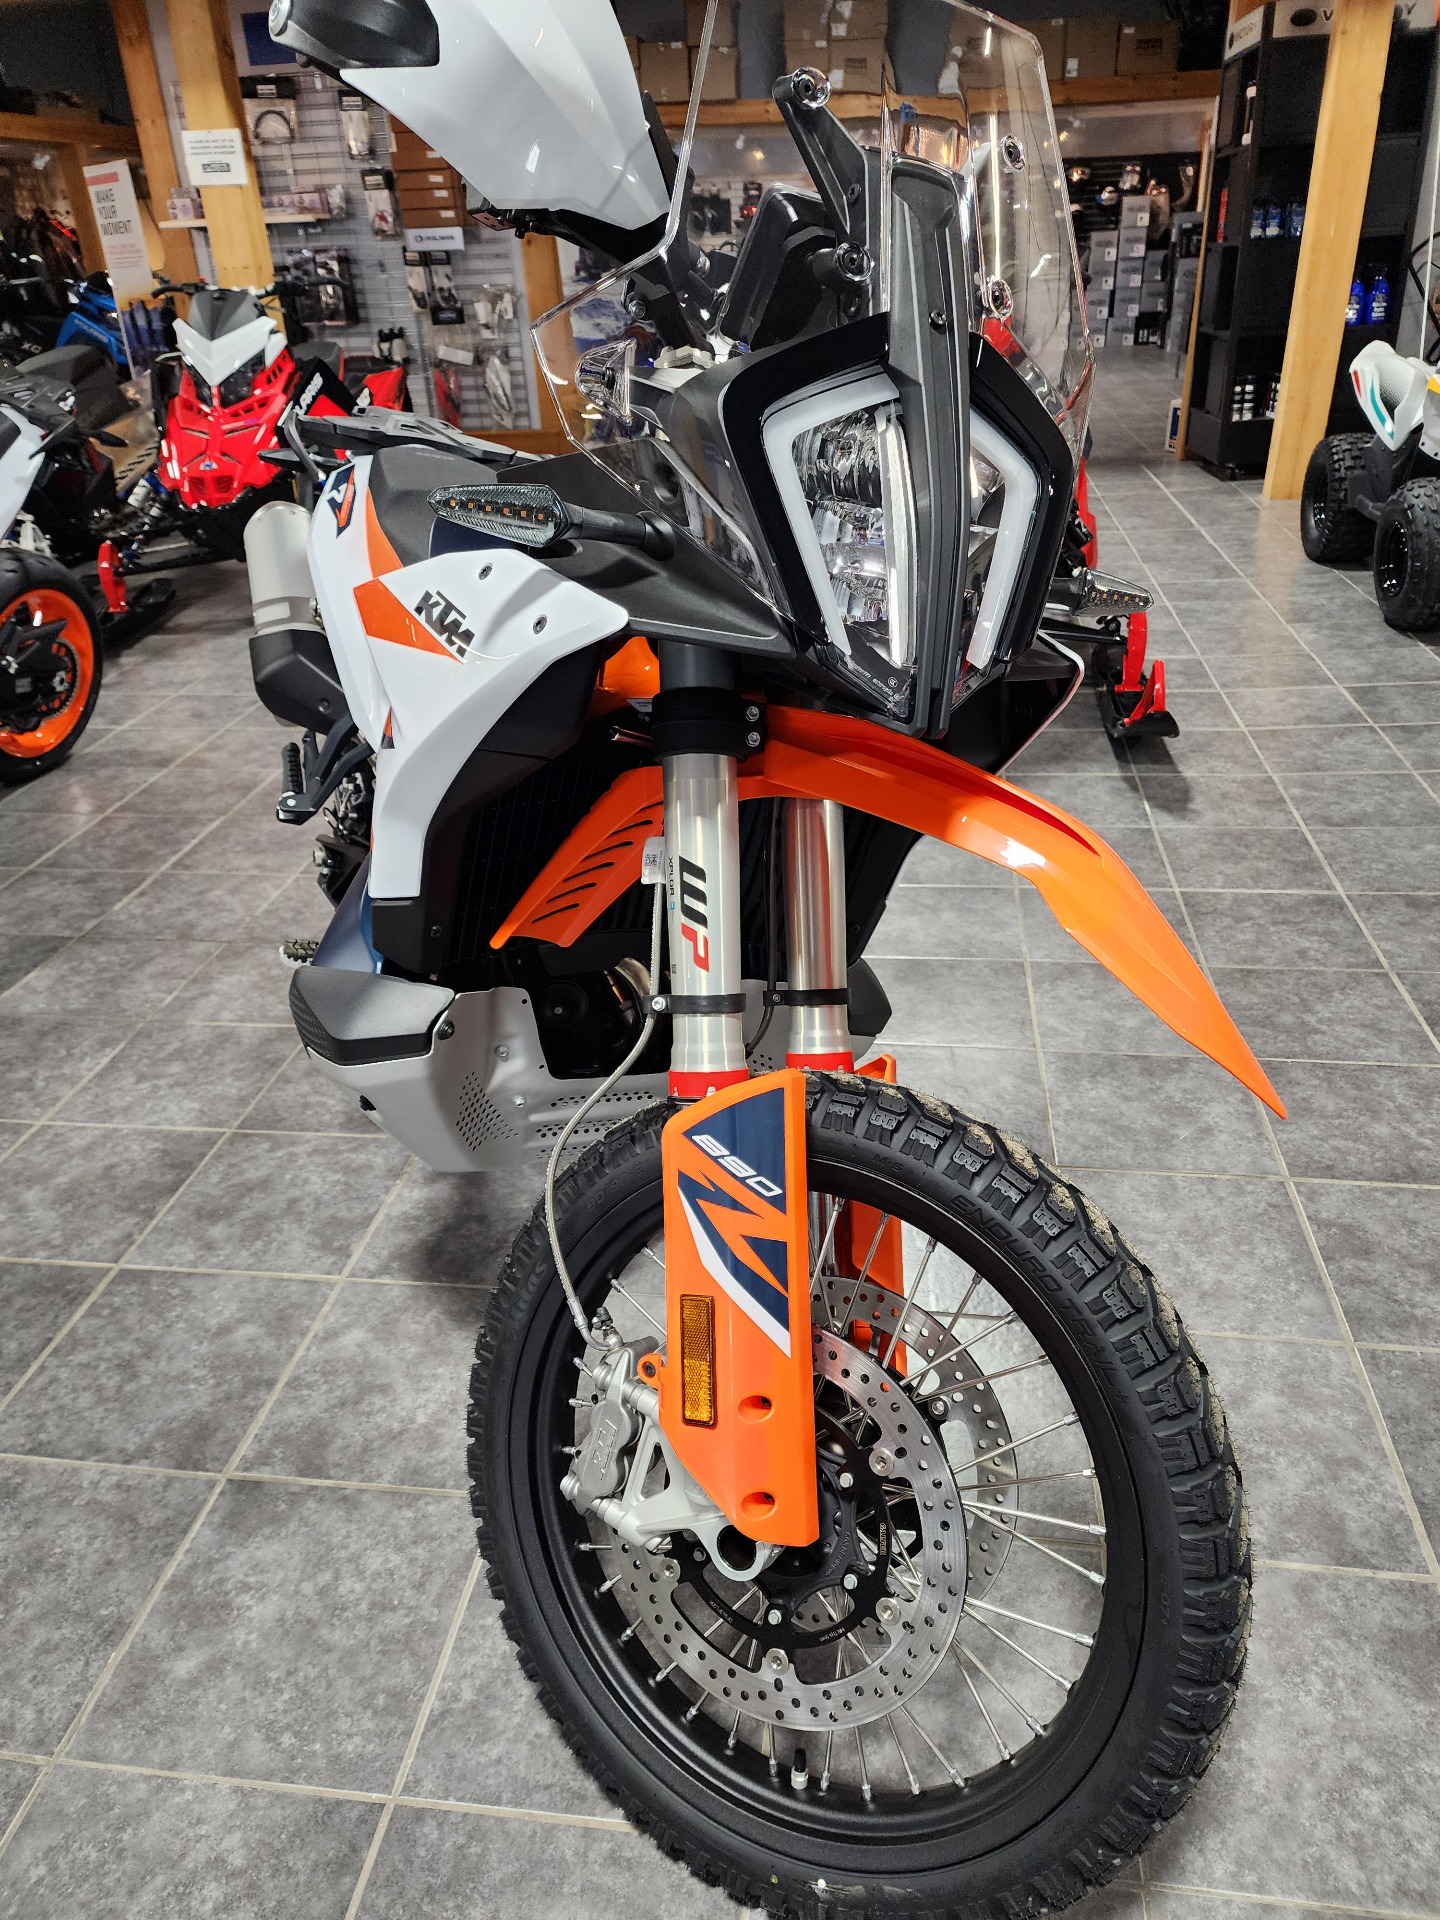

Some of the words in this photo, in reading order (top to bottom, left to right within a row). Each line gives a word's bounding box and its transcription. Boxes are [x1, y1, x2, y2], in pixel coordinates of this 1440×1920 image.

[413, 590, 476, 659] KTM
[679, 855, 709, 973] WP
[691, 1134, 783, 1197] 890
[950, 1194, 1063, 1294] ENDURO
